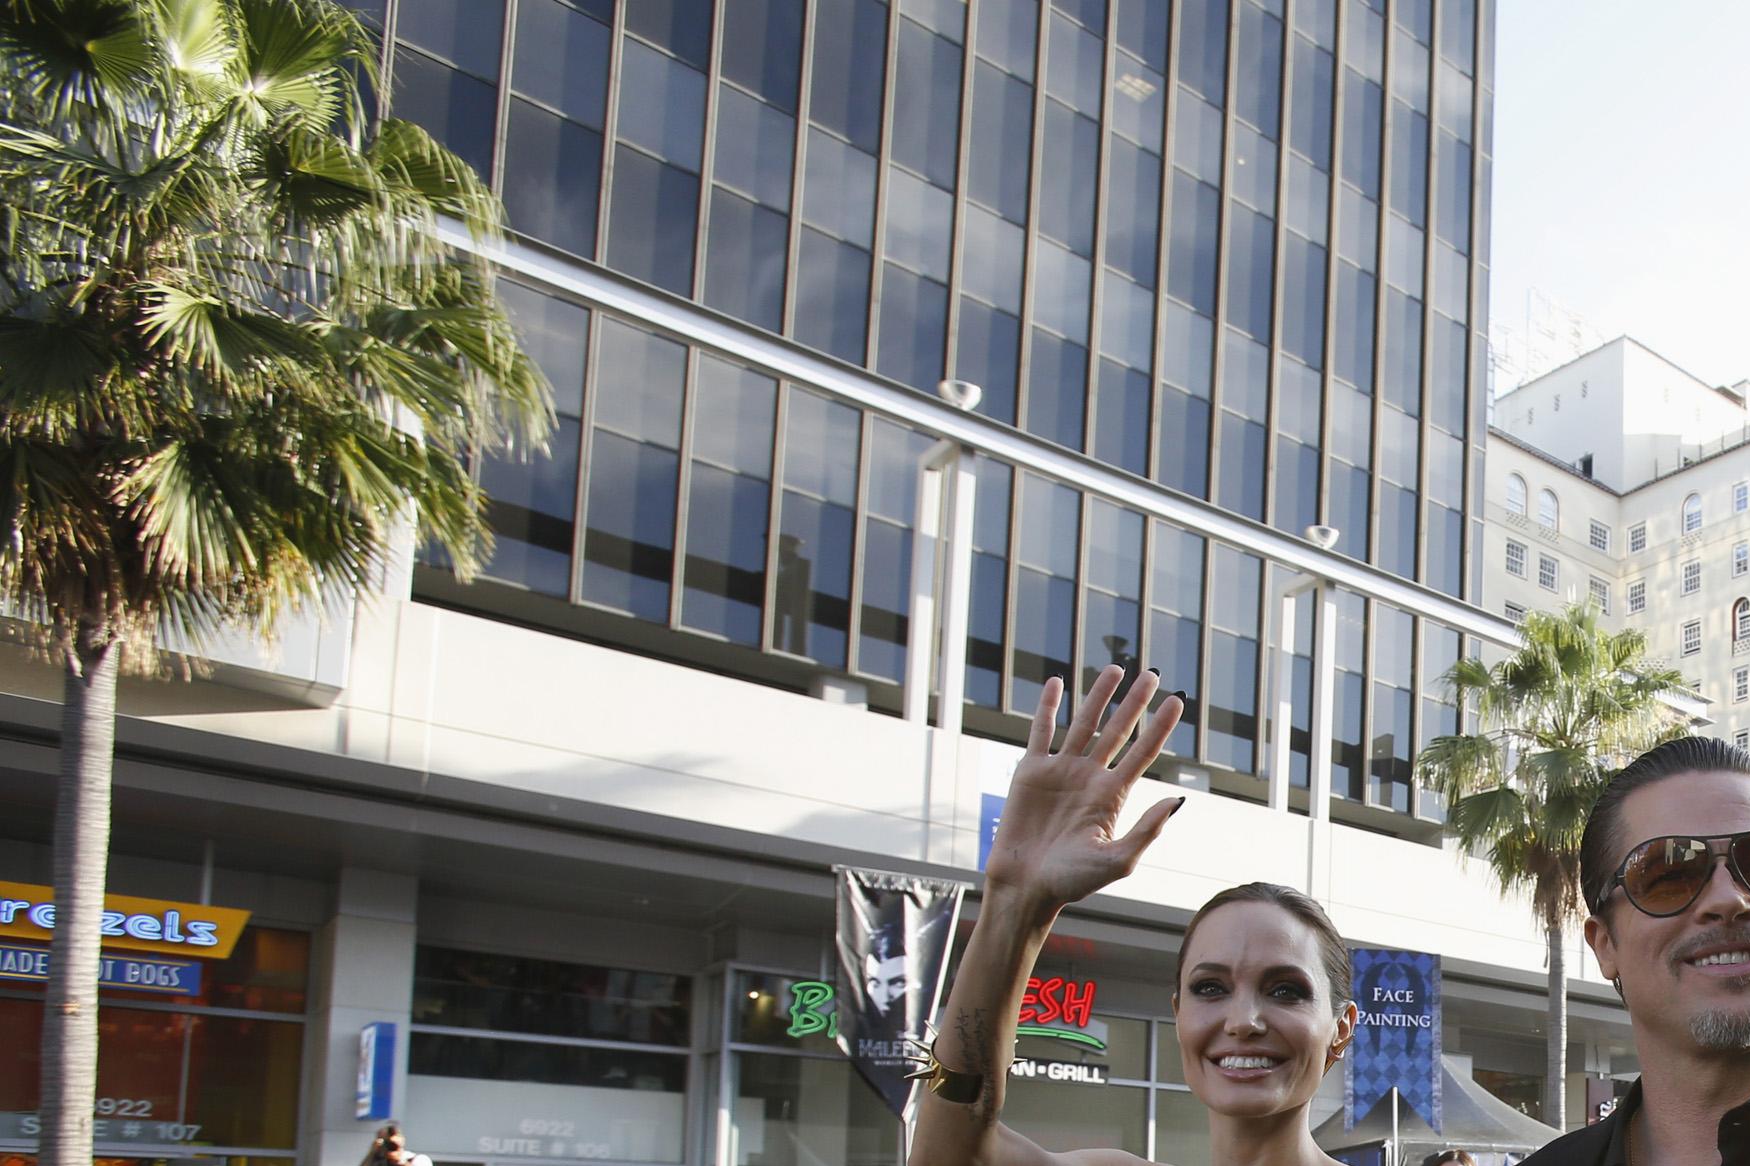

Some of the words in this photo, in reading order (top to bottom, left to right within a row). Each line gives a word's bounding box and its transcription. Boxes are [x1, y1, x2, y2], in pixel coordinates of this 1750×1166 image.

[0, 899, 219, 947] rezels
[0, 950, 48, 975] ADE
[1017, 976, 1097, 1029] ESH
[1373, 987, 1414, 1003] FACE
[1357, 1010, 1431, 1028] PAINTING
[1047, 1064, 1106, 1084] GRILL
[96, 1097, 153, 1117] 922
[156, 1122, 202, 1141] 107
[477, 1136, 542, 1156] SUITE
